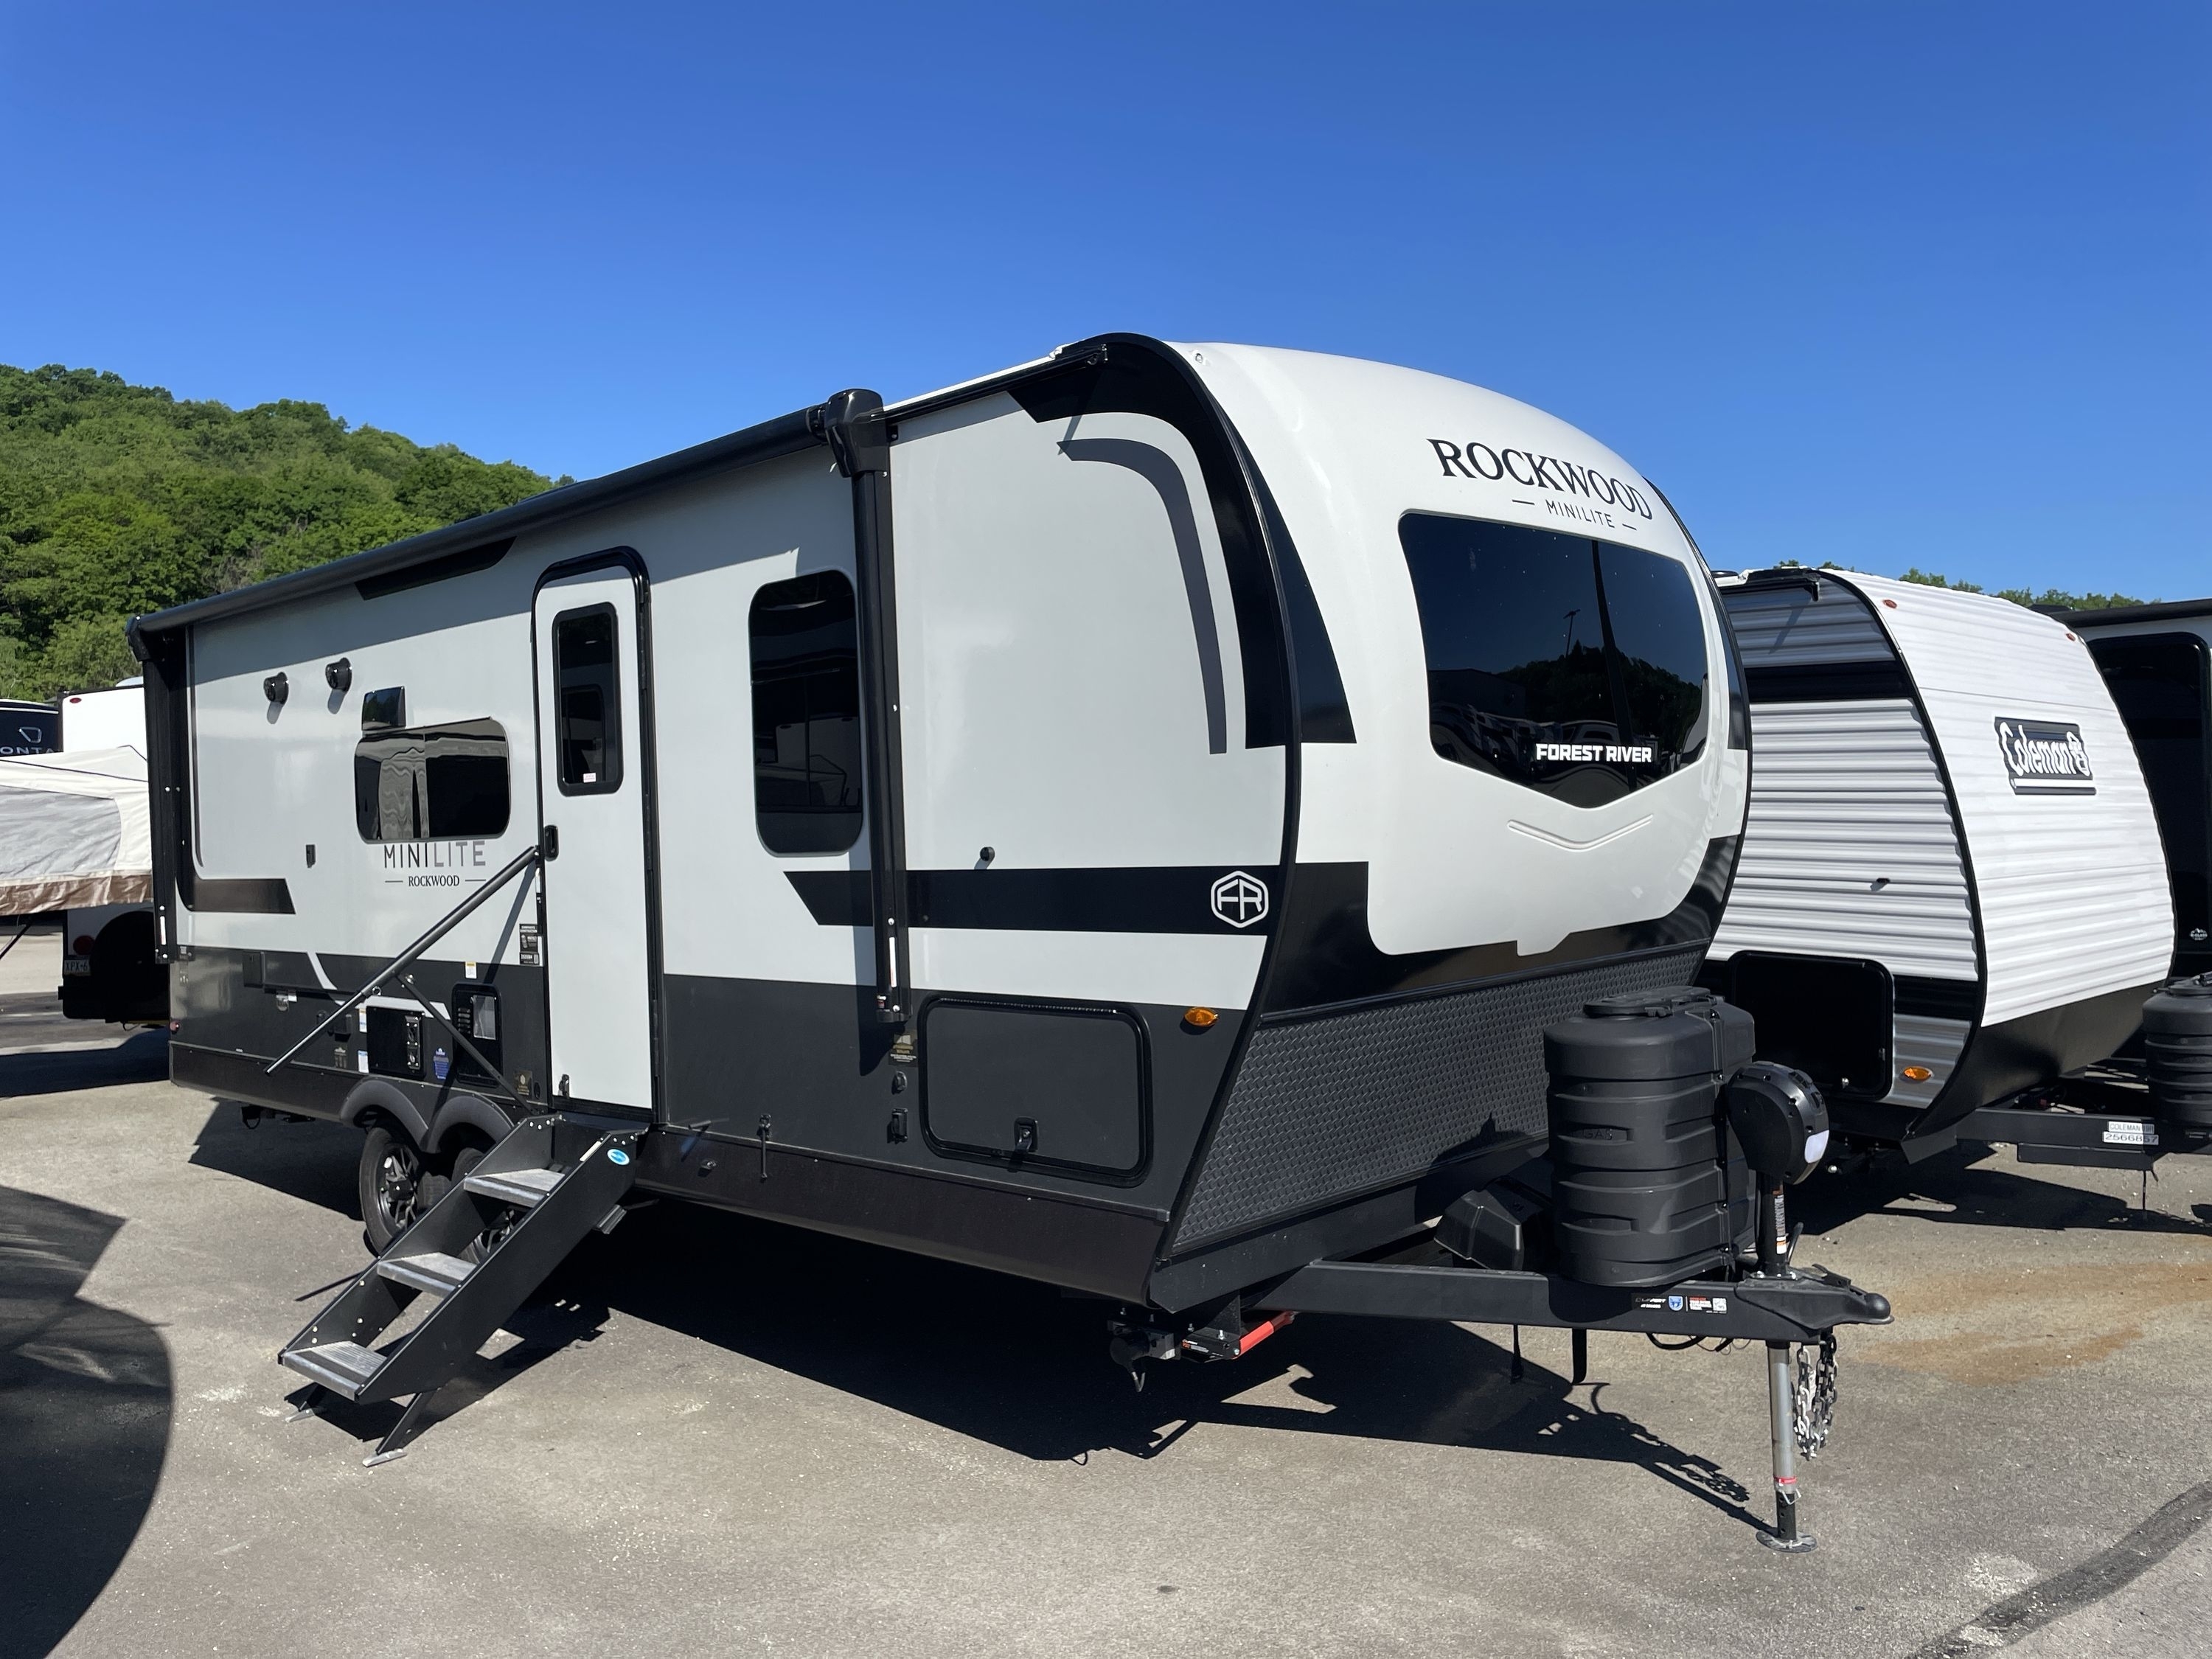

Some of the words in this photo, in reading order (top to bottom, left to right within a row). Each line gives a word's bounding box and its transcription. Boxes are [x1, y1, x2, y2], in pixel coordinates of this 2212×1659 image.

[1426, 438, 1652, 520] ROCKWOOD
[1545, 499, 1615, 529] MINILITE
[1536, 743, 1603, 762] FOREST
[1605, 745, 1652, 763] RIVER
[1999, 722, 2077, 776] Coleman
[384, 841, 486, 869] MINILITE
[408, 875, 460, 887] ROCKWOOD
[2110, 1123, 2141, 1132] COLEMAN
